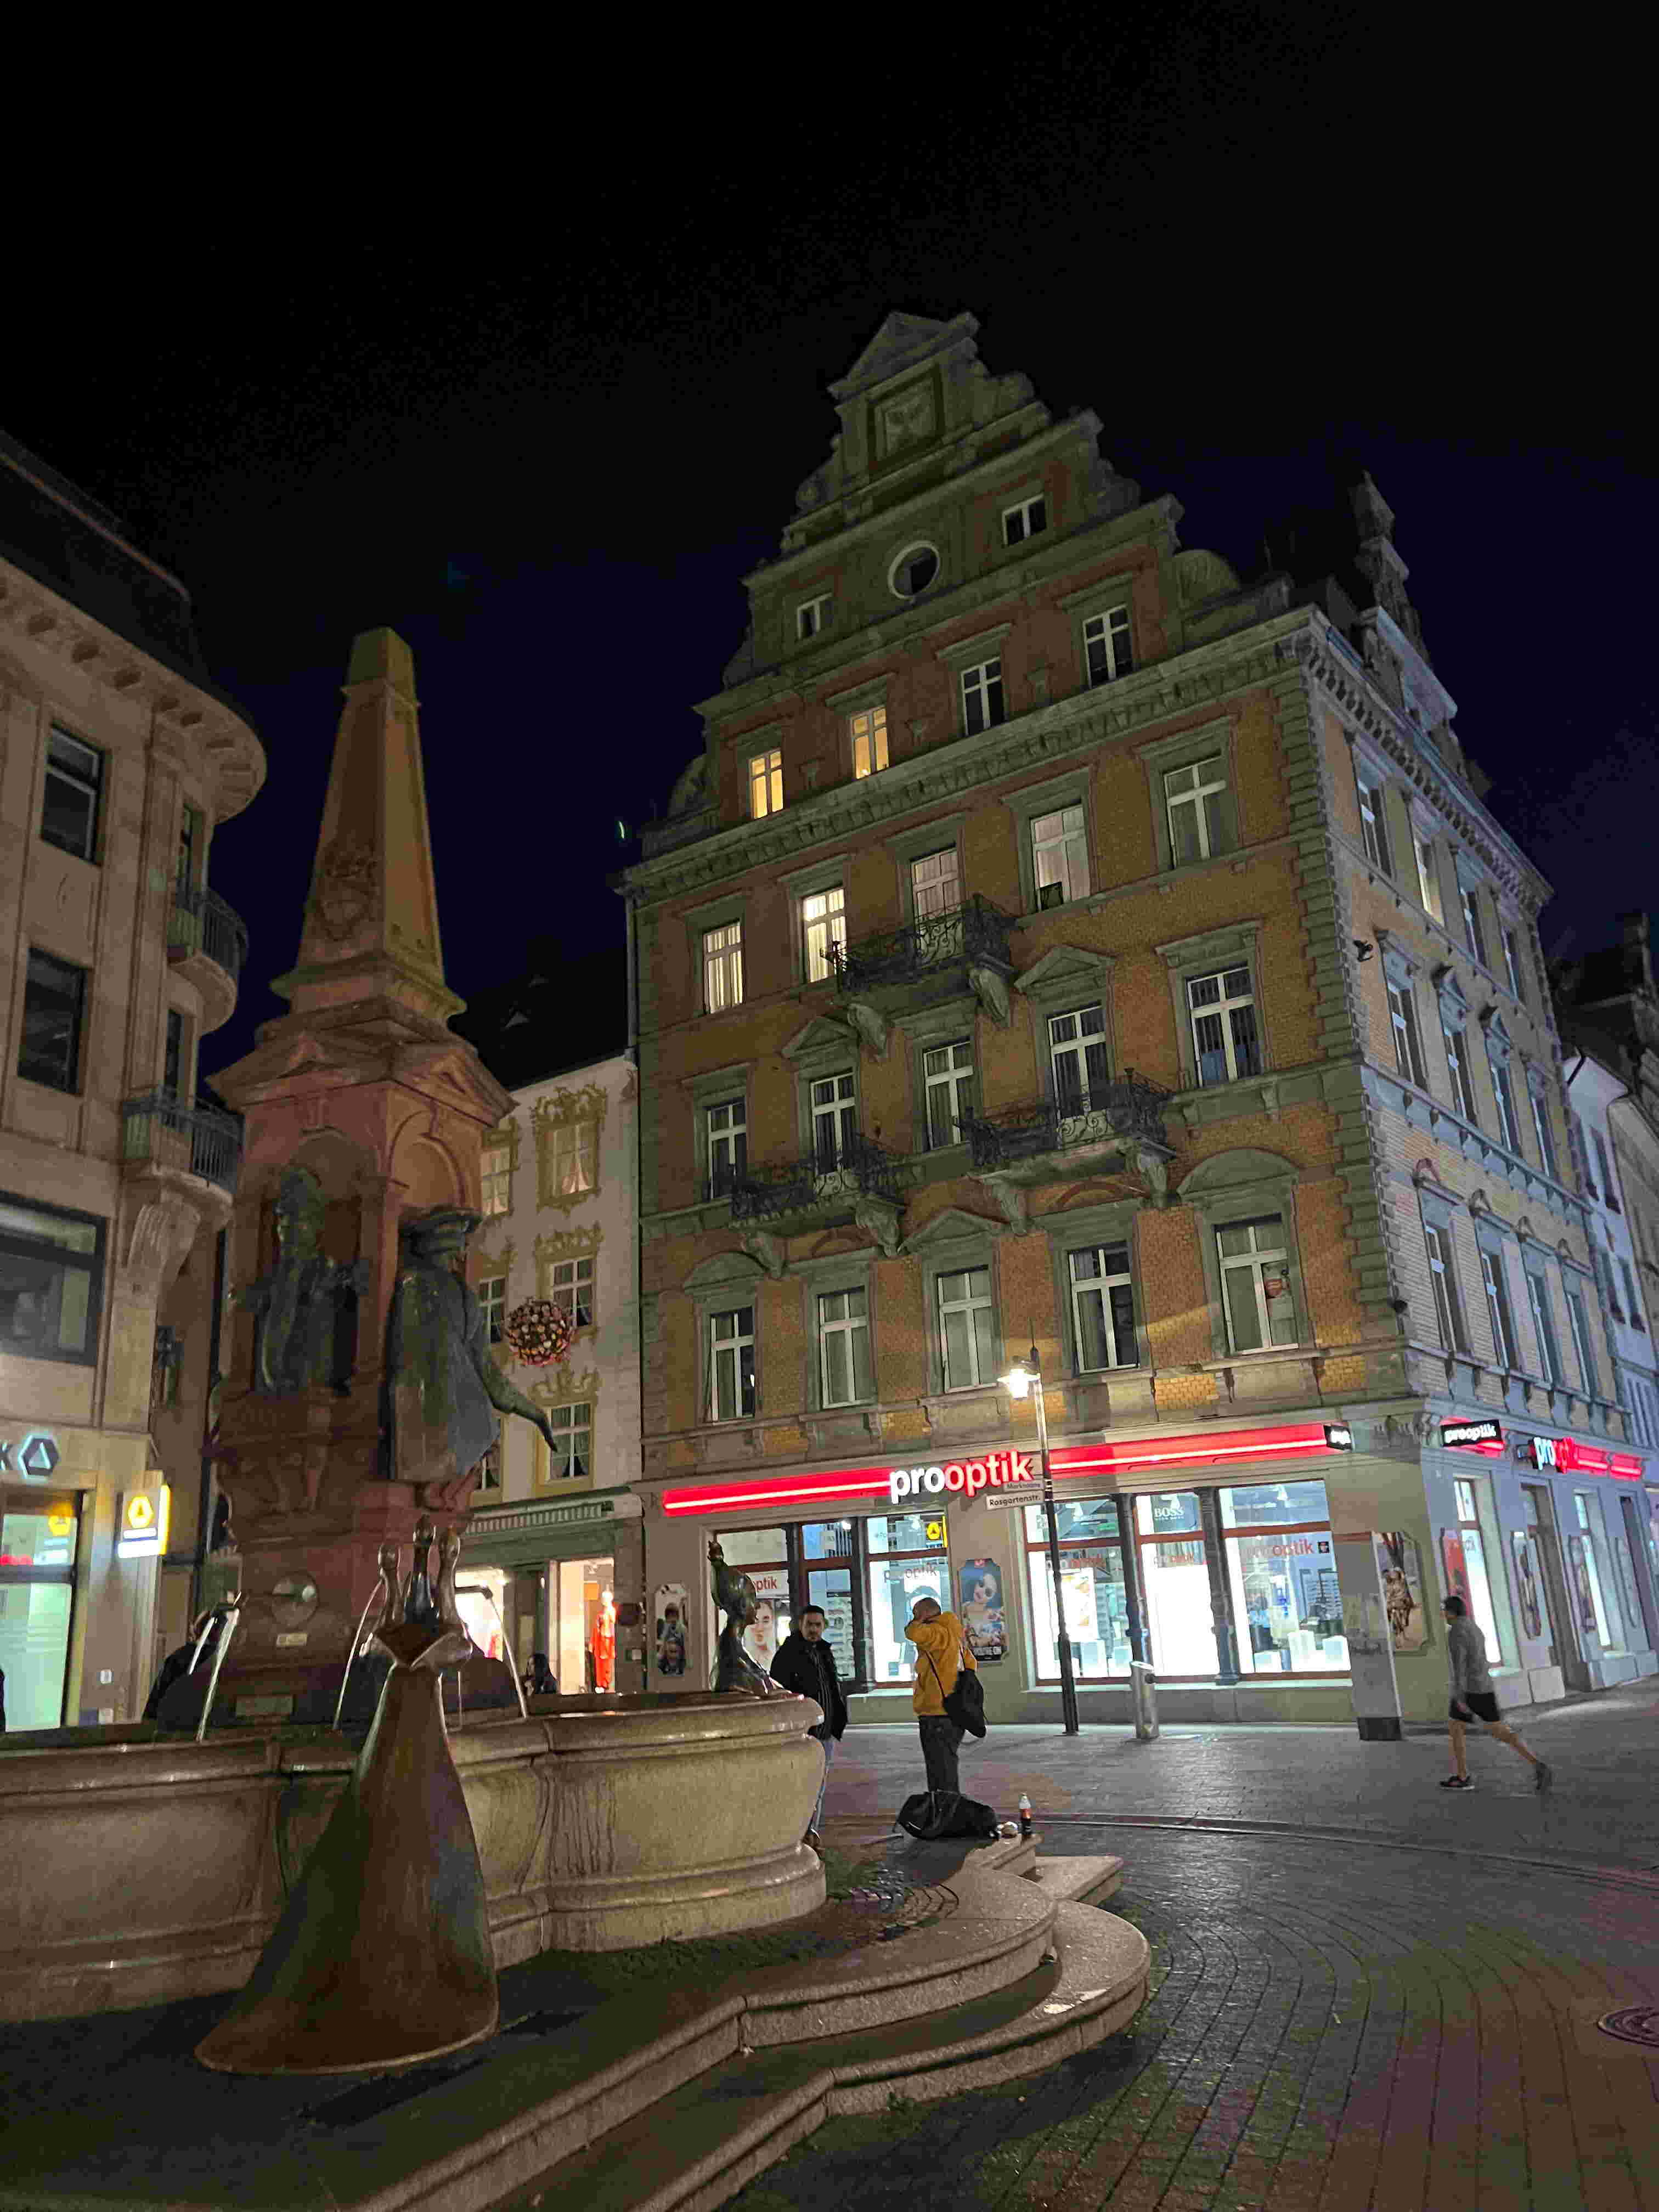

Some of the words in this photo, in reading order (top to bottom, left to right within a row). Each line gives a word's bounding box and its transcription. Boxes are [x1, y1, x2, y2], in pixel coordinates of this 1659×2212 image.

[889, 1451, 1035, 1504] prooptik
[989, 1495, 1041, 1506] Rosgartenstr.
[1154, 1506, 1185, 1517] BOSS
